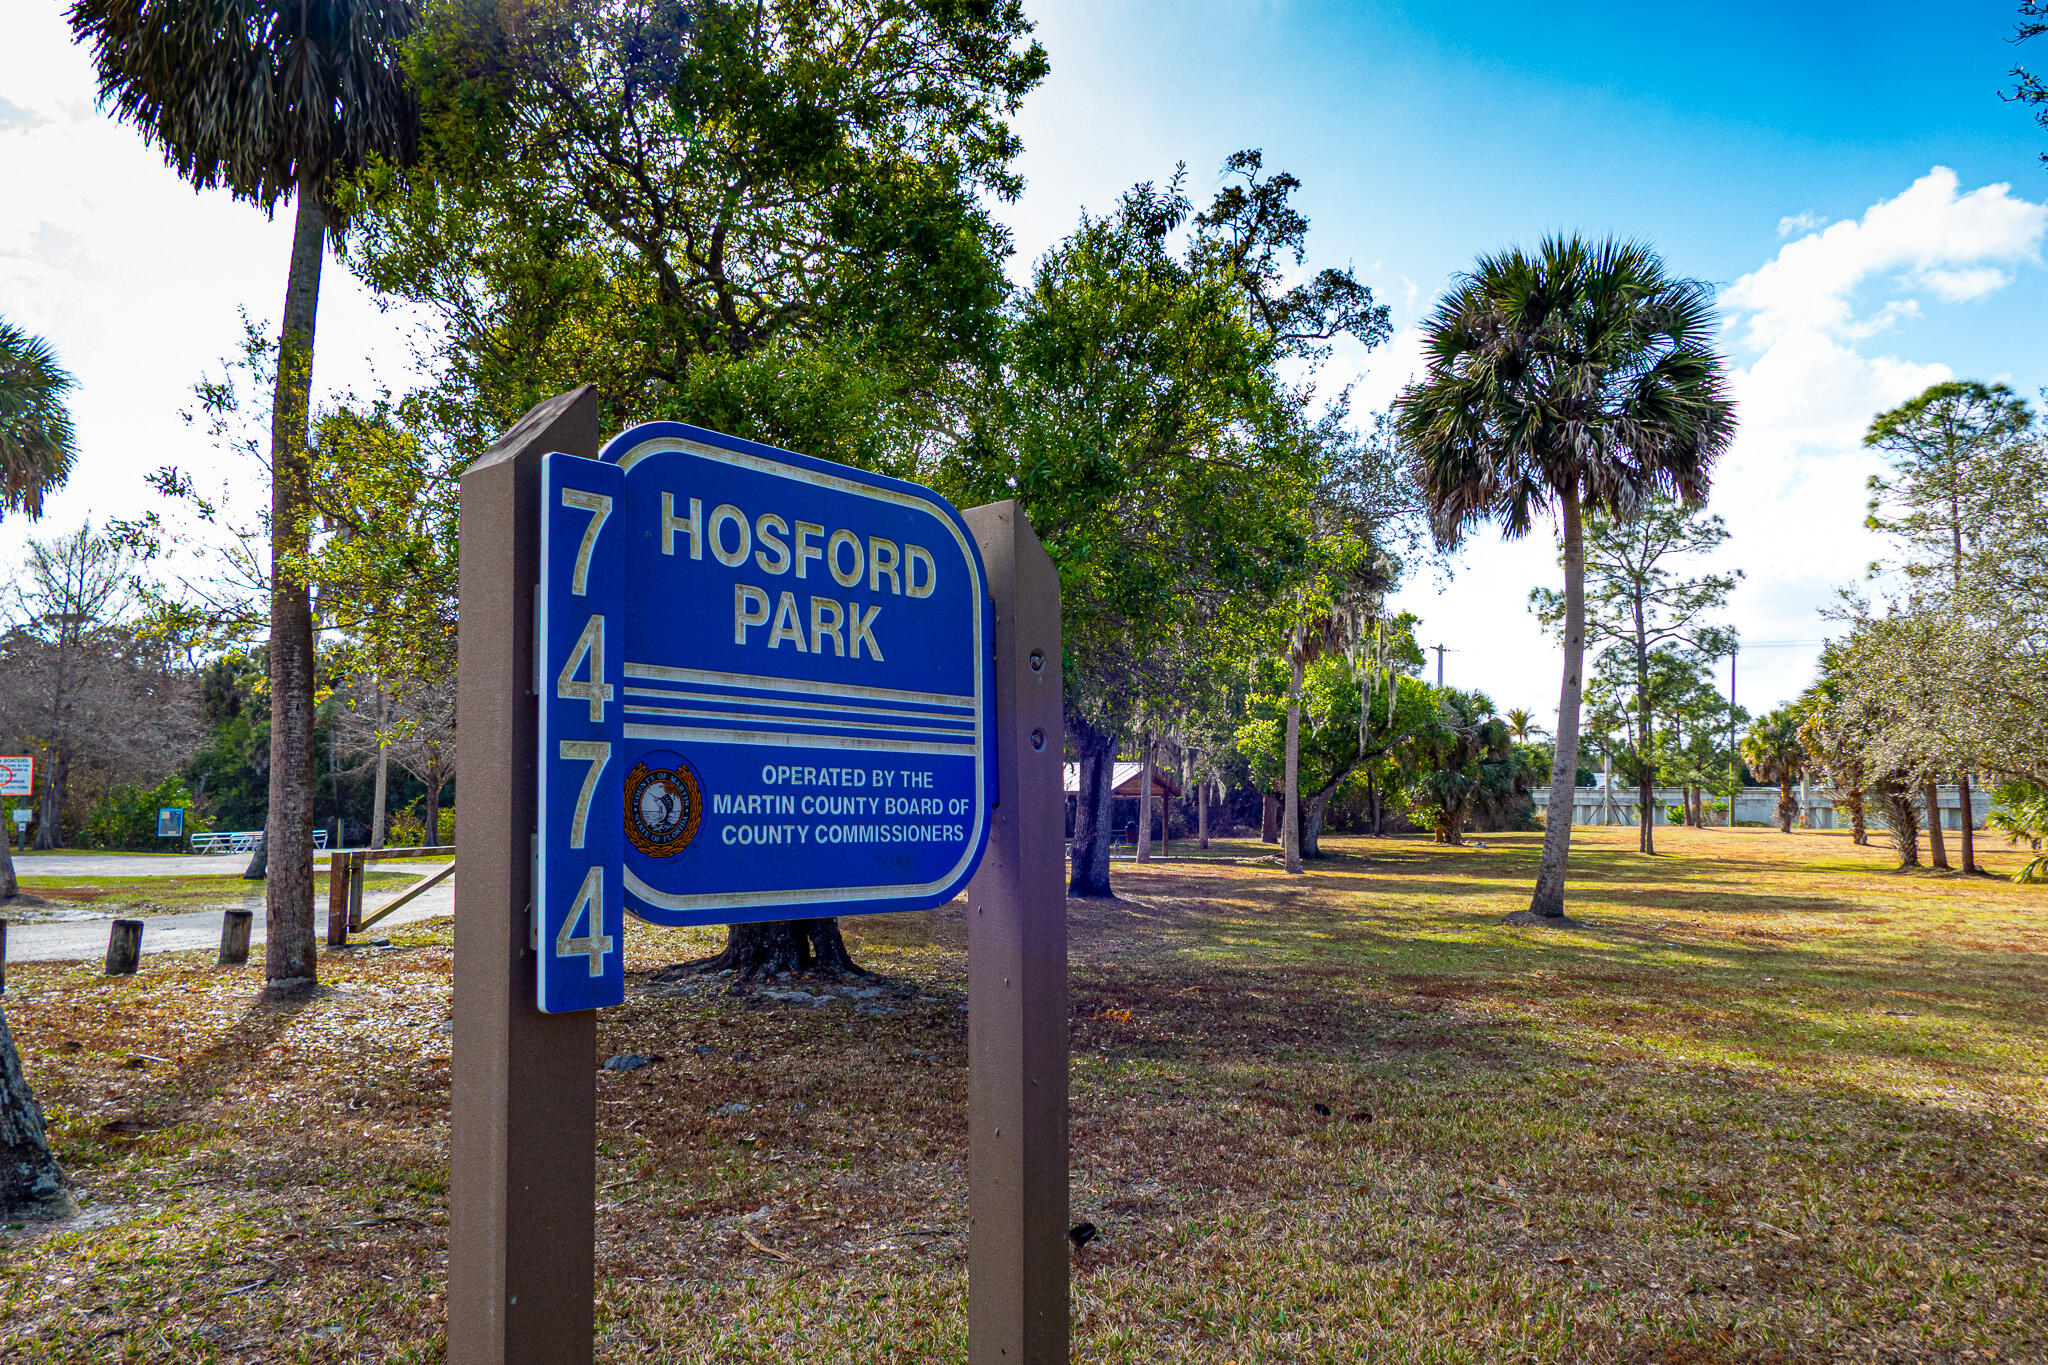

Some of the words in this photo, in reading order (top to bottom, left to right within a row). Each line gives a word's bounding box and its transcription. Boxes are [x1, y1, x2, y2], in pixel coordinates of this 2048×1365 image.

[661, 491, 937, 599] HOSFORD
[734, 583, 885, 662] PARK
[633, 774, 656, 806] COUNTY
[657, 772, 668, 780] OF
[669, 775, 690, 807] MARTIN
[762, 764, 866, 787] OPERATED
[872, 769, 895, 788] BY
[900, 770, 934, 788] THE
[713, 794, 795, 815] MARTIN
[801, 795, 879, 816] COUNTY
[885, 797, 943, 815] BOARD
[948, 798, 970, 816] OF
[634, 814, 650, 839] STATE
[651, 834, 661, 843] OF
[662, 815, 689, 843] FLORIDA
[721, 825, 809, 845] COUNTY
[815, 824, 965, 843] COMMISSIONERS
